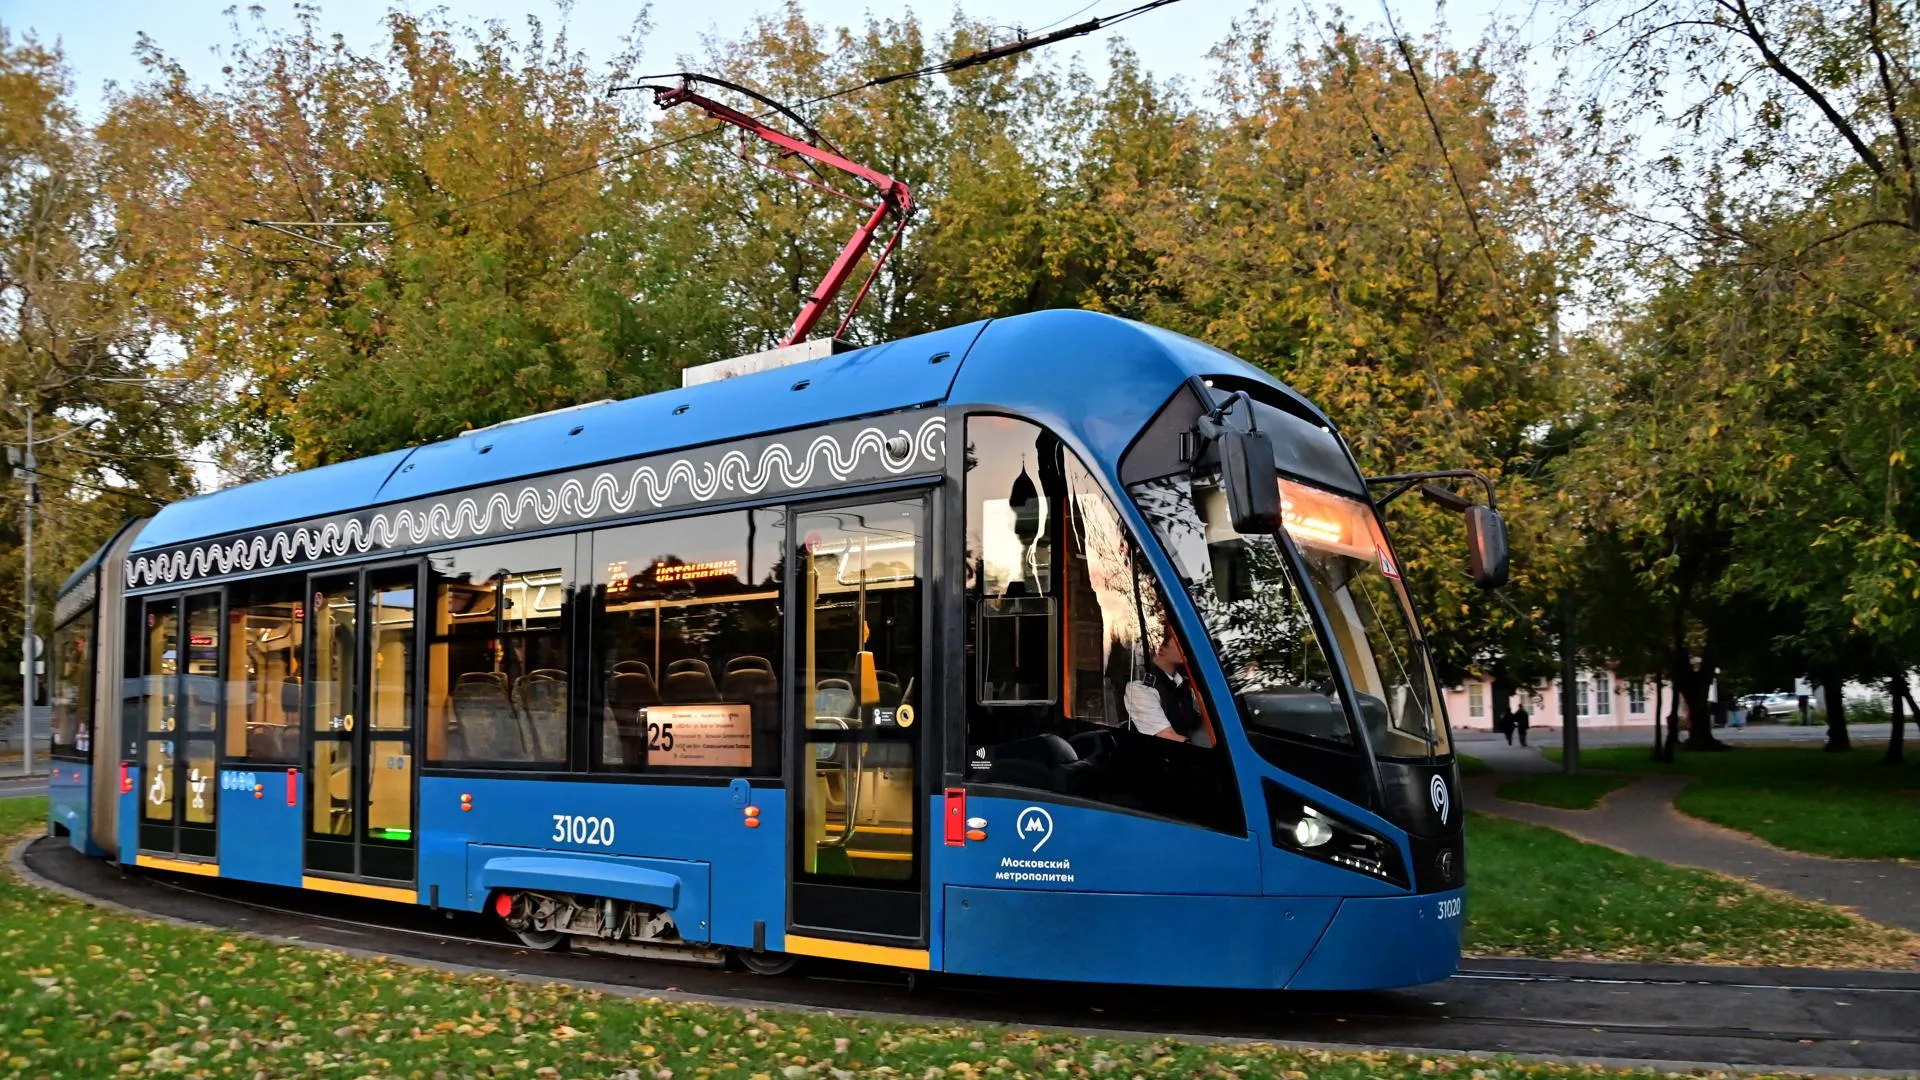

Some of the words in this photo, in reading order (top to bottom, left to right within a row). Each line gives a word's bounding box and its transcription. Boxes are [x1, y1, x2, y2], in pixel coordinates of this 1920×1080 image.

[648, 723, 674, 752] 25
[552, 814, 615, 846] 31020
[1000, 857, 1070, 869] Московский
[995, 871, 1075, 883] метрополитен
[1437, 897, 1461, 919] 31020
